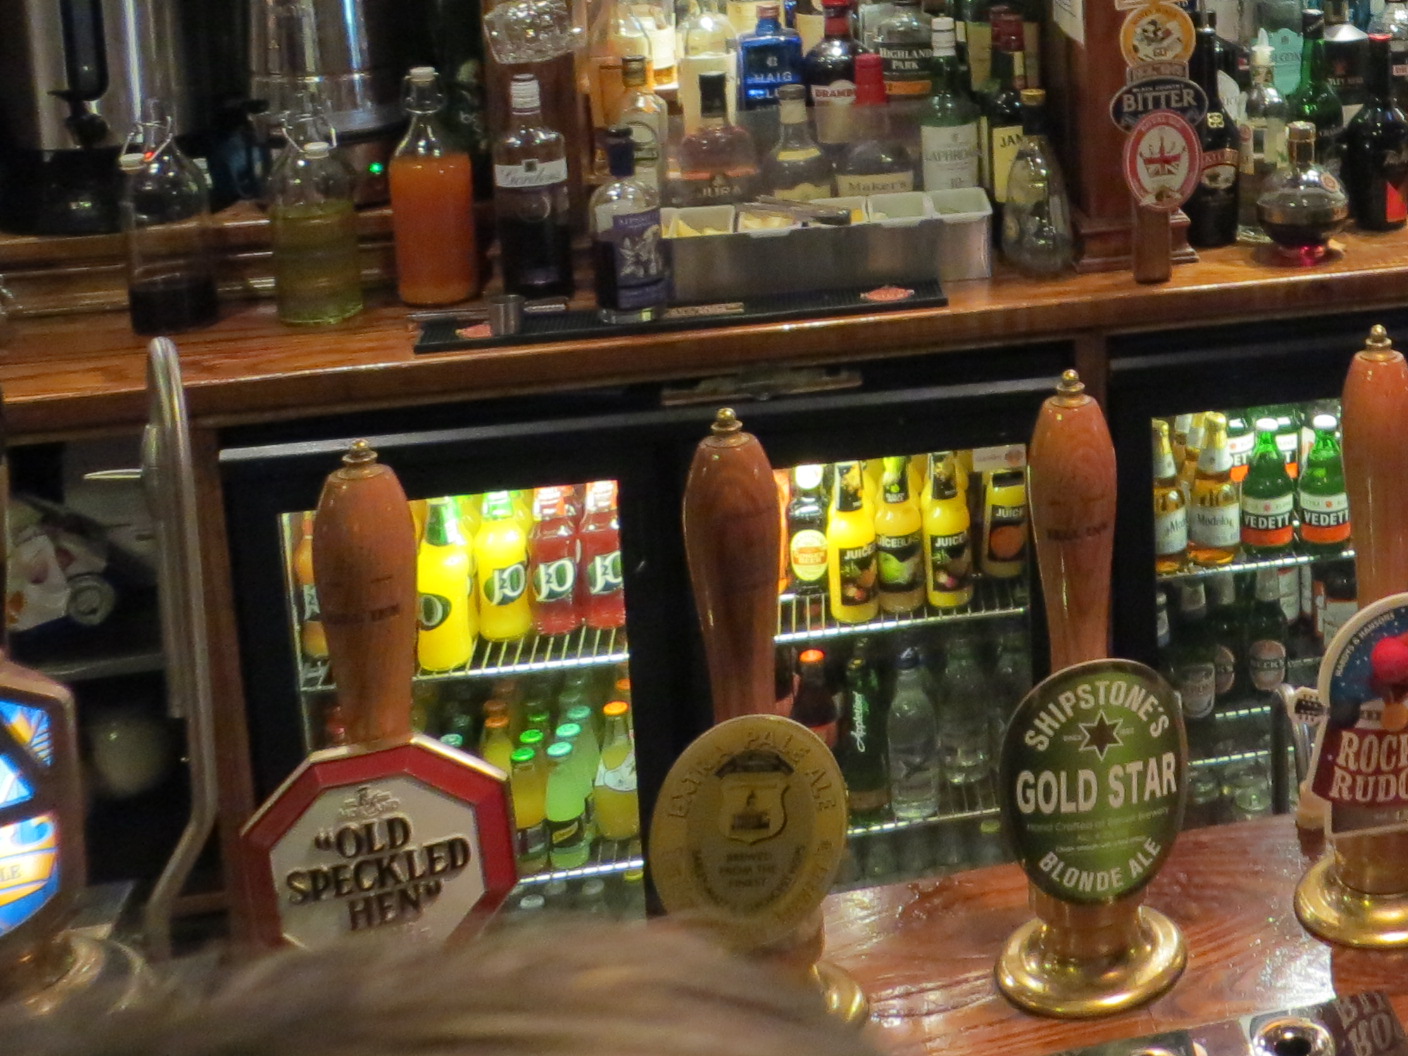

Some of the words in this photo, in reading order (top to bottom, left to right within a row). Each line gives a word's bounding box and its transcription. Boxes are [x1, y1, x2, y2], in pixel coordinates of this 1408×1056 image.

[878, 46, 934, 59] HIGHLAND
[891, 59, 920, 71] PARK
[753, 70, 794, 83] HAIG
[1122, 88, 1198, 113] BITTER
[1243, 512, 1291, 529] VEDETT
[1303, 508, 1350, 526] VEDETT
[1024, 680, 1170, 752] SHIPSTONE'S
[803, 767, 837, 812] ALE
[1015, 768, 1098, 814] GOLD
[1107, 751, 1177, 809] STAR
[285, 836, 472, 905] SPECKLED
[1038, 849, 1126, 893] BLONDE
[1127, 837, 1163, 879] ALE
